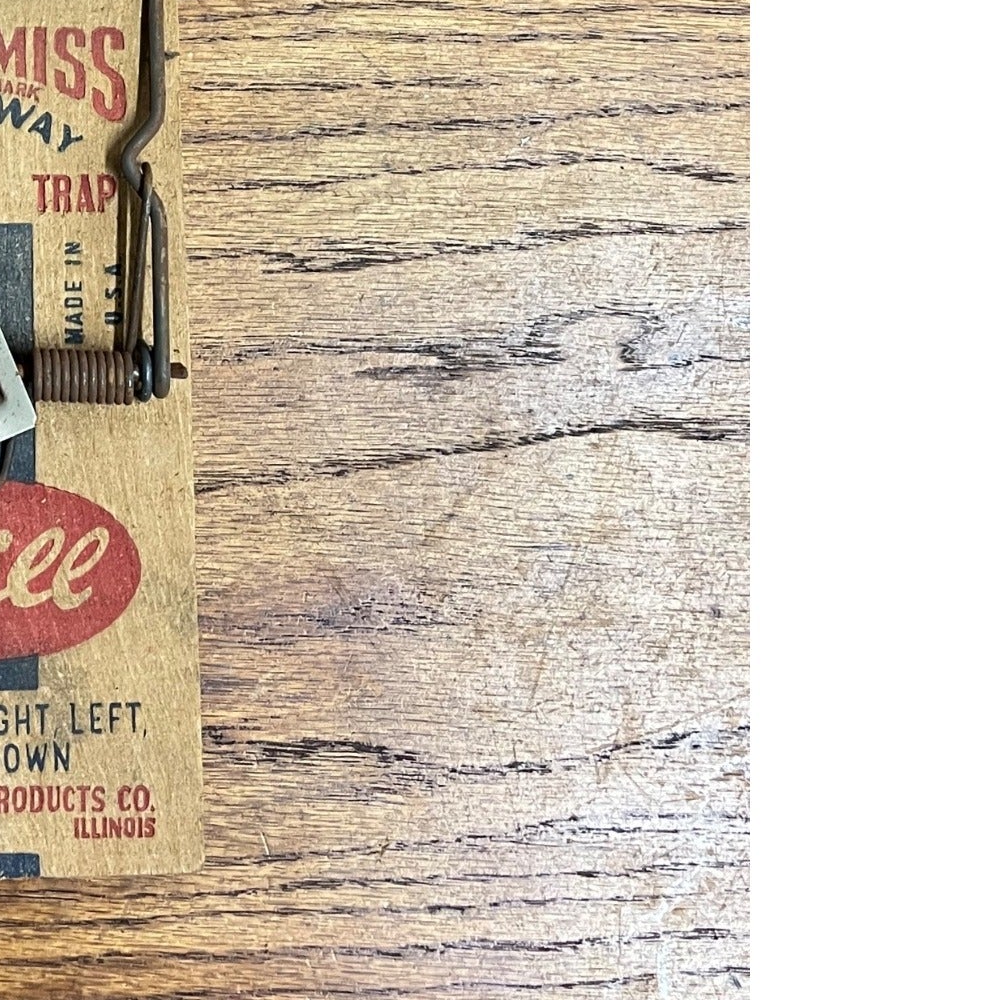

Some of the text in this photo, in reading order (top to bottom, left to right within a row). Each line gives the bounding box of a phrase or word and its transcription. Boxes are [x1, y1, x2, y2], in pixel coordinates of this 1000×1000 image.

[33, 174, 117, 213] TRAP
[64, 242, 84, 344] MADE IN
[70, 702, 147, 738] LEFT,
[117, 784, 156, 812] CO.
[73, 816, 156, 839] ILLINOIS
